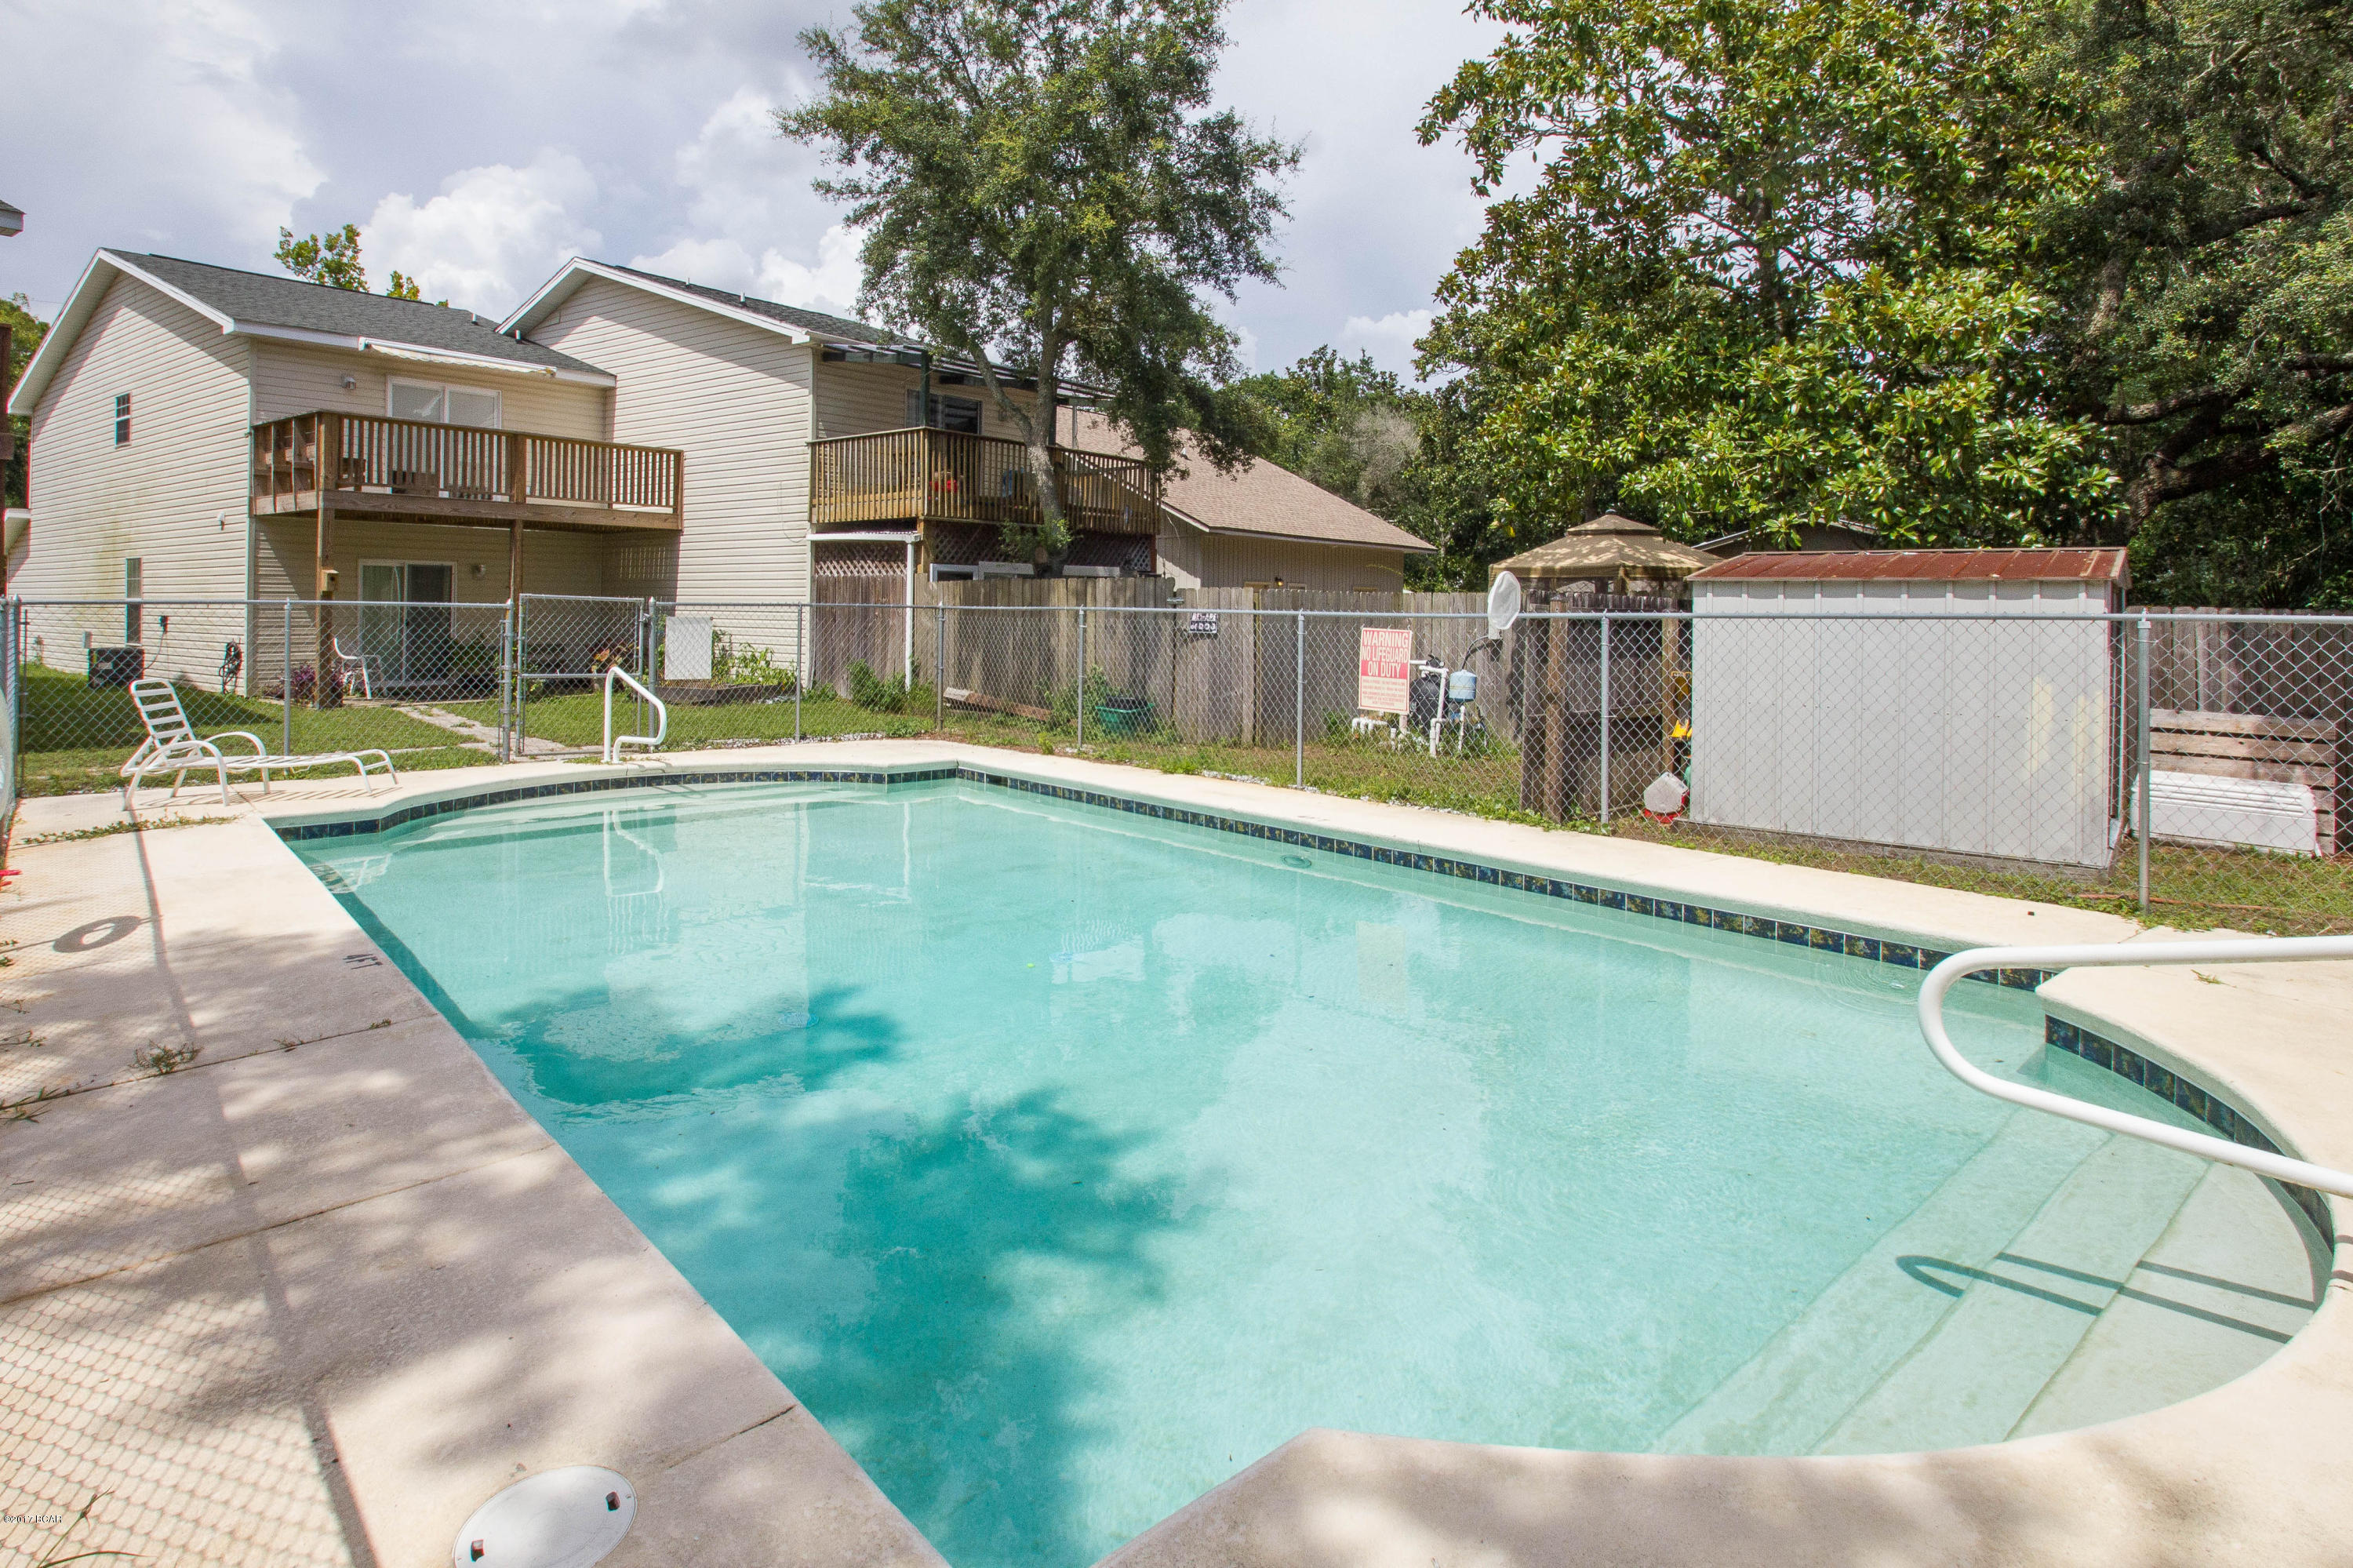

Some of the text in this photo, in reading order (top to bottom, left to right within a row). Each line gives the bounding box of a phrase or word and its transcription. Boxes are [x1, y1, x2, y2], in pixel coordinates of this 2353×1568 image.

[1363, 631, 1409, 648] WARNING
[1362, 646, 1408, 664] NO LIFEGUARD
[1368, 661, 1401, 678] ON DUTY
